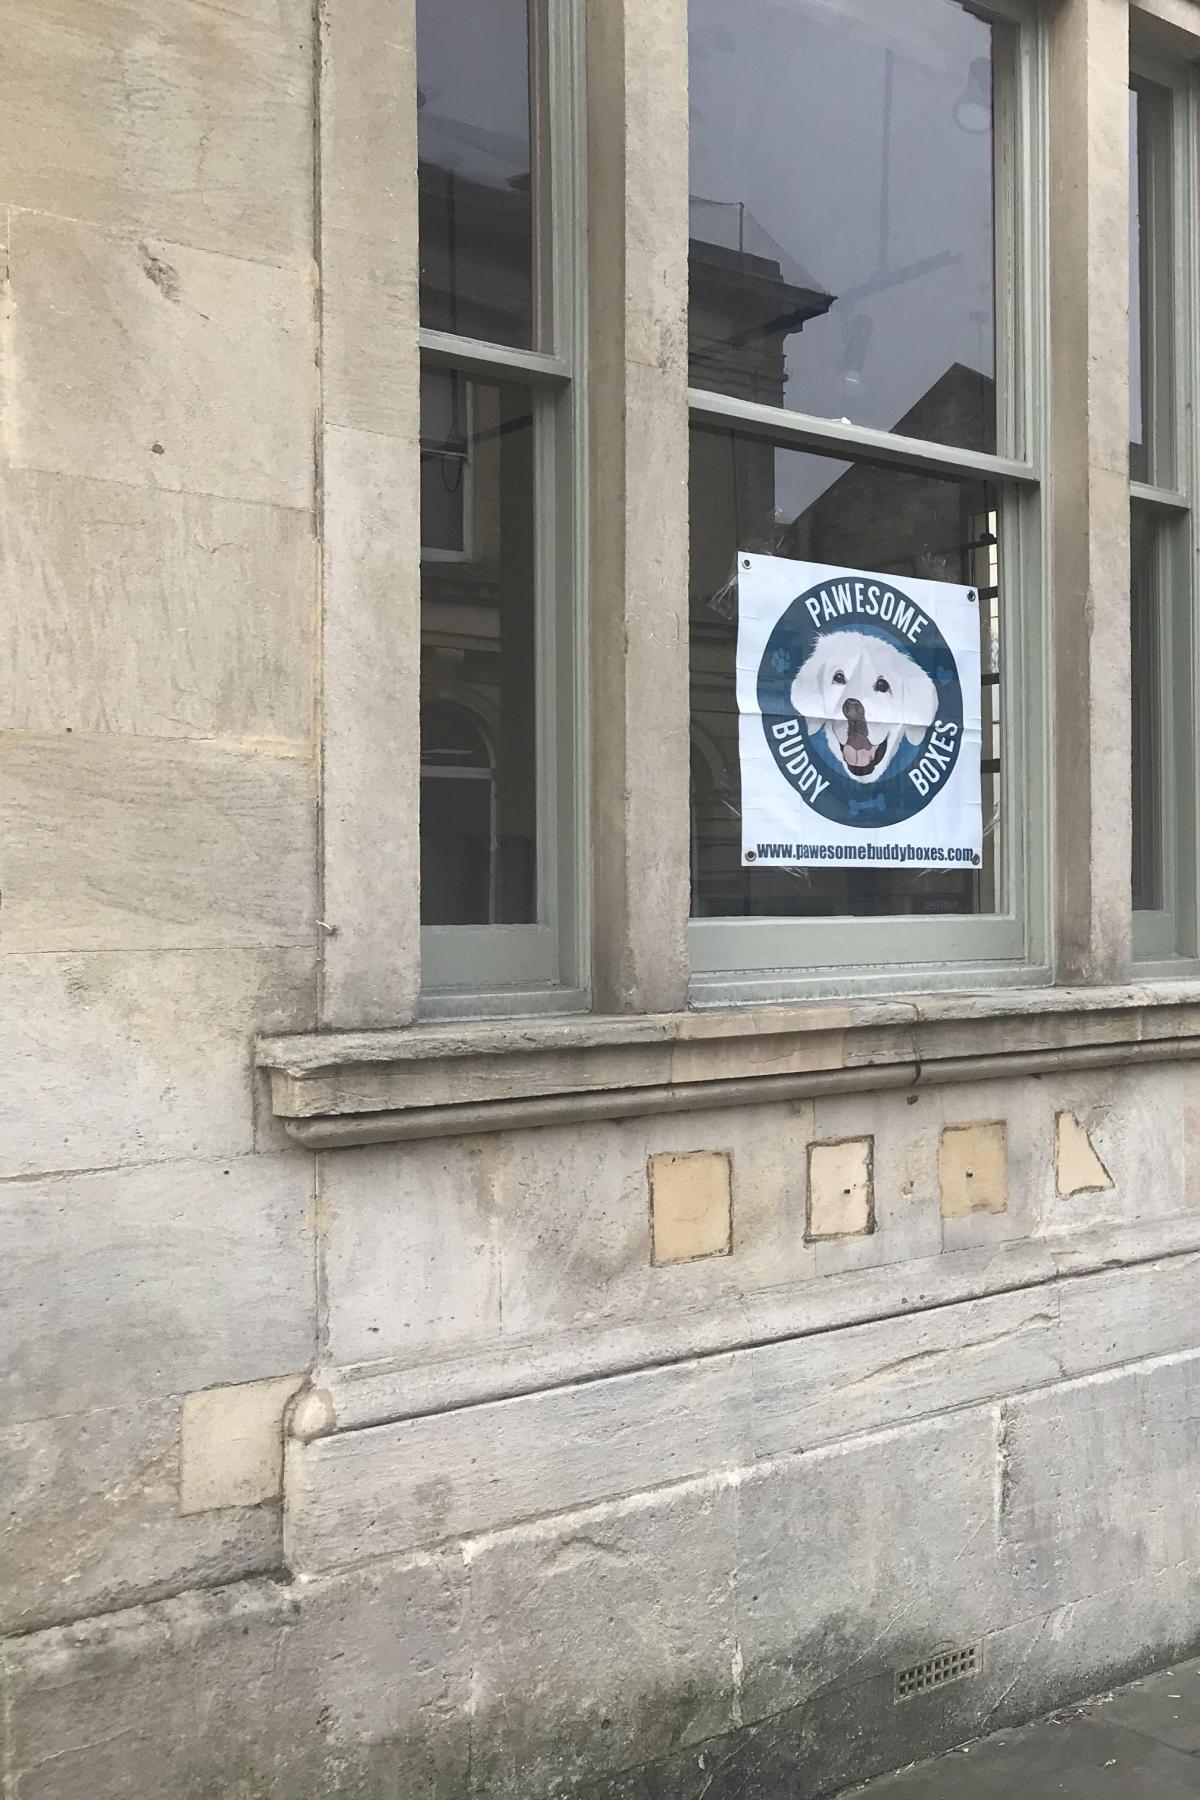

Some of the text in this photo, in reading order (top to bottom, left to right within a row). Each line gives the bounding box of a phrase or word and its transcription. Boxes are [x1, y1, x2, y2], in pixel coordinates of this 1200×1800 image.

[805, 583, 929, 643] PAWESOME
[772, 719, 830, 803] BUDDY
[908, 719, 958, 797] BOXES
[756, 843, 974, 862] www.pawesomebuddyboxes.com
